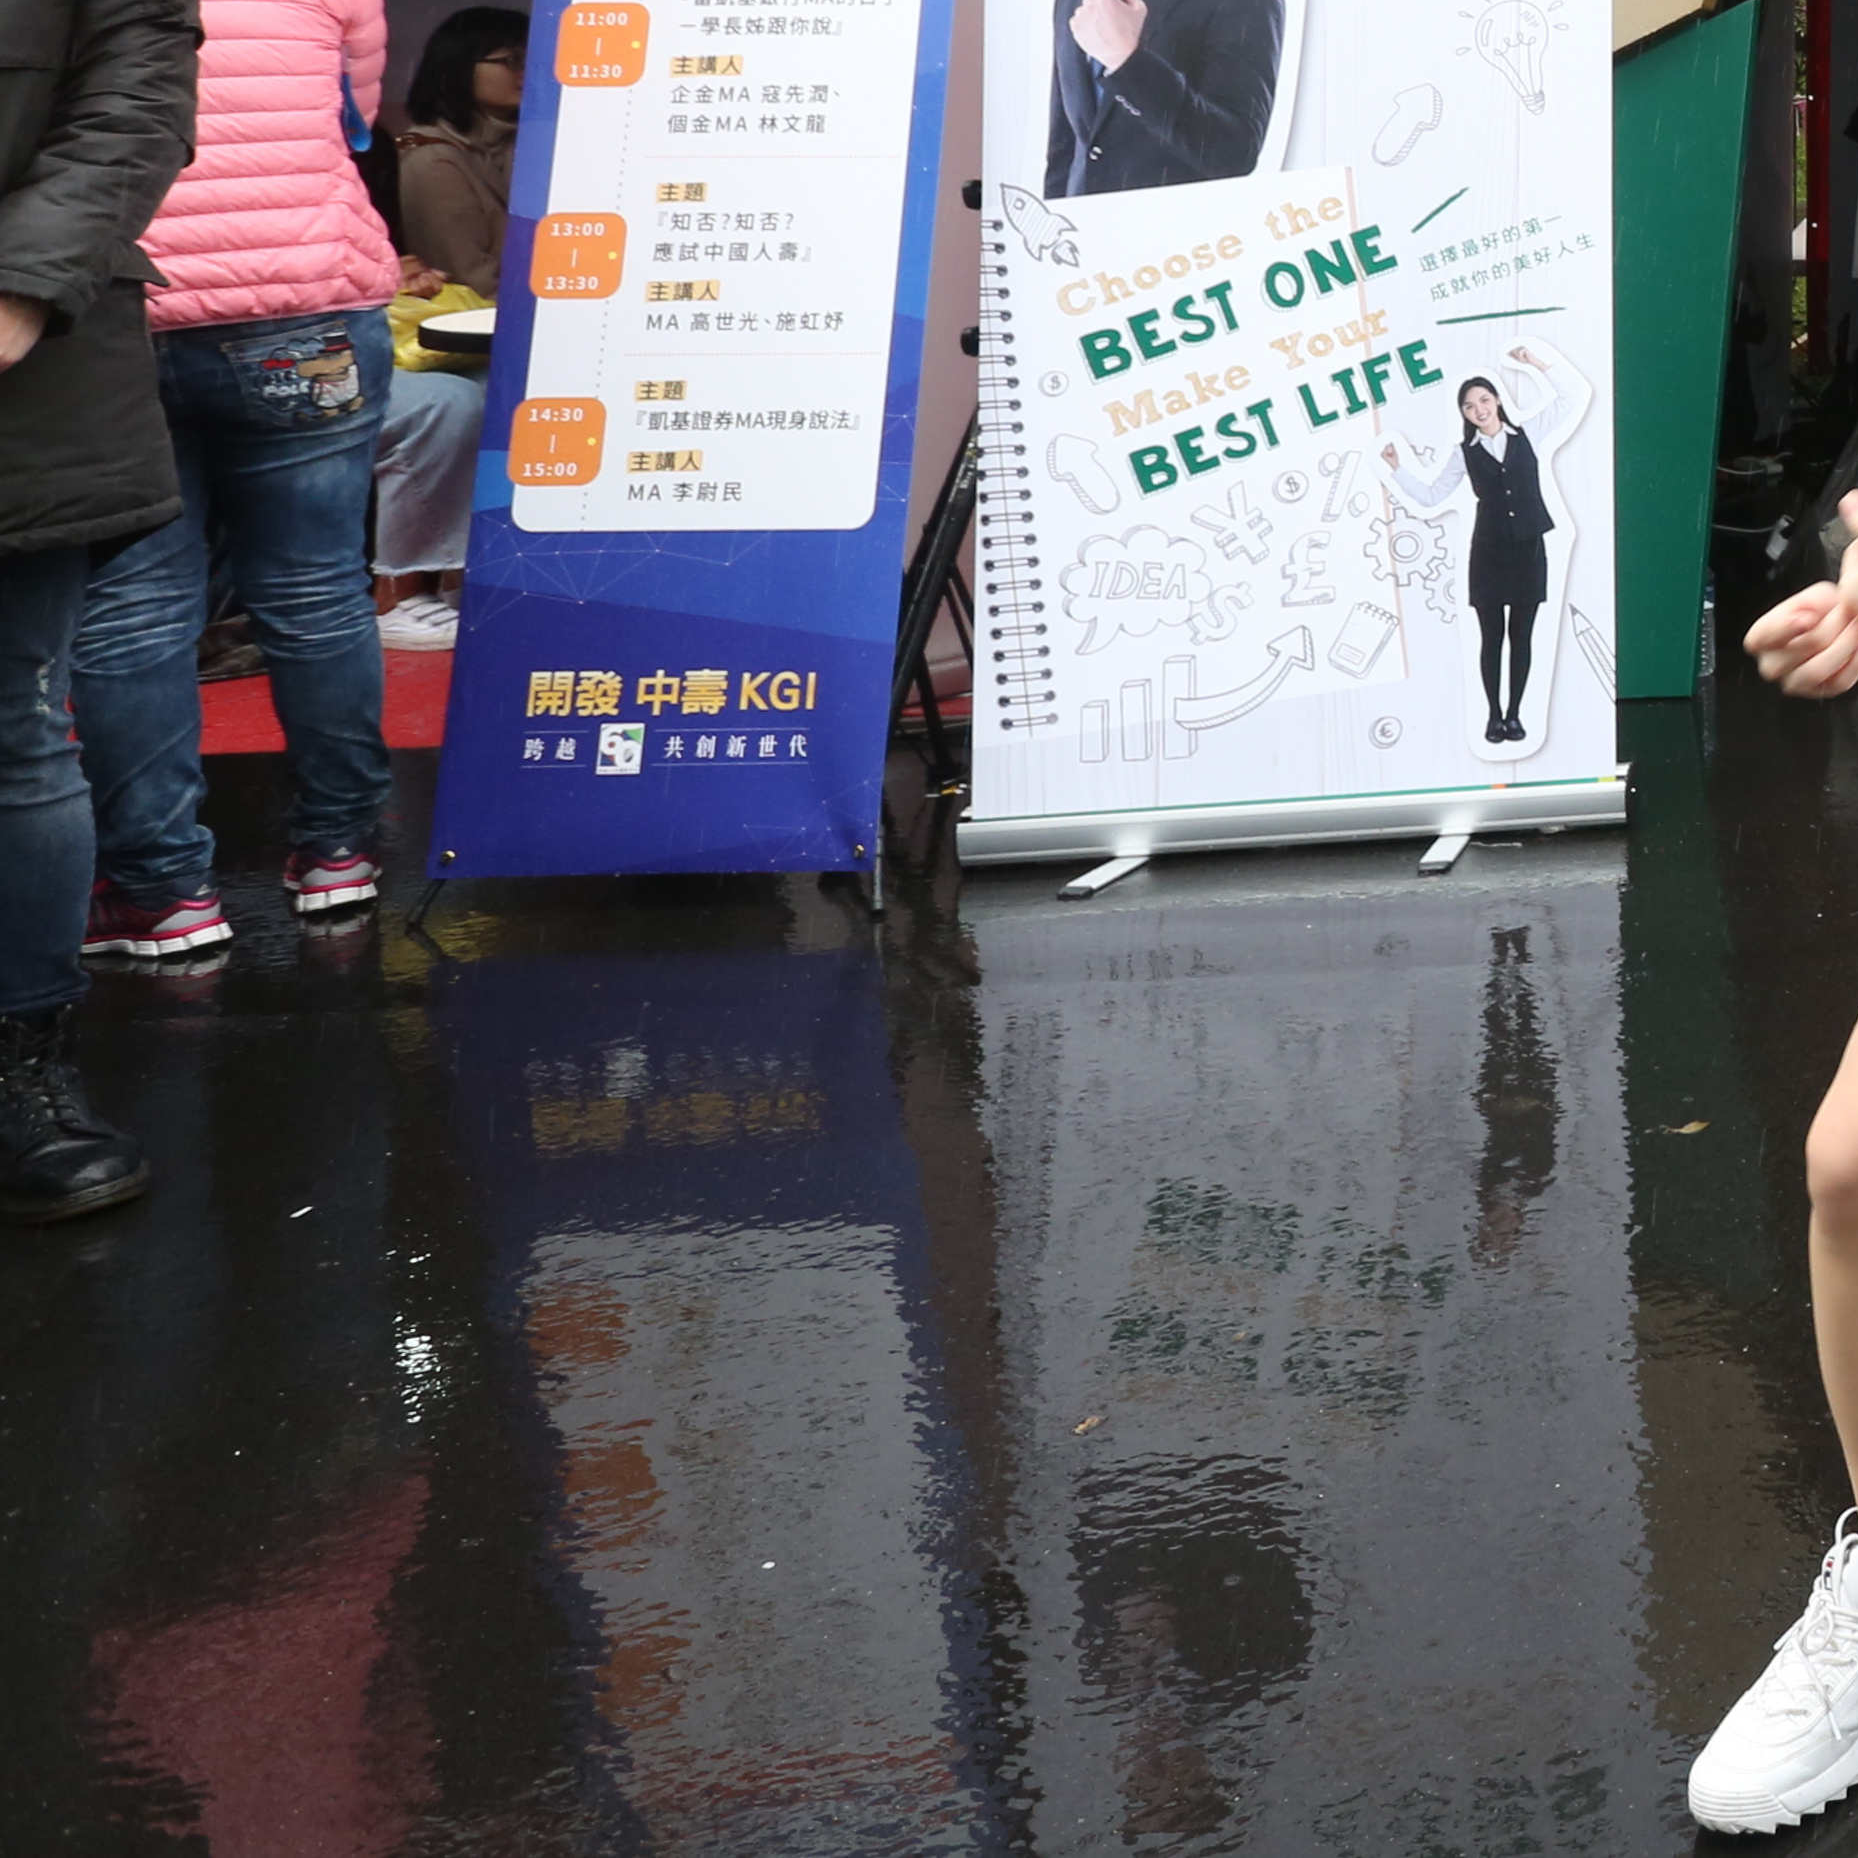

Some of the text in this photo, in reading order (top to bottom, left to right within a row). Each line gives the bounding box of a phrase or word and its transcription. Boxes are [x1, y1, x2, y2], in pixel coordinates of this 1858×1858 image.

[574, 12, 629, 27] 11:00
[568, 64, 623, 79] 11:30
[672, 55, 742, 75] 主講人
[670, 84, 752, 105] 企金MA
[667, 113, 828, 135] 個金MA 林文龍
[658, 182, 705, 203] 主題
[550, 222, 606, 237] 13:00
[1057, 192, 1348, 318] Choose the
[1418, 215, 1563, 273] 選擇最好的第一
[1429, 232, 1596, 303] 成就你的美好人生
[544, 276, 599, 291] 13:30
[647, 281, 719, 303] 主講人
[1077, 224, 1399, 384] BEST ONE
[645, 313, 680, 331] MA
[1102, 307, 1390, 438] Make Your
[636, 380, 685, 402] 主題
[527, 407, 584, 423] 14:30
[1127, 338, 1445, 500] BEST LIFE
[521, 462, 578, 478] 15:00
[628, 450, 701, 472] 主講人
[627, 483, 662, 502] MA
[1087, 560, 1188, 603] IDEA
[525, 668, 818, 718] 開發 中壽 KGI
[522, 737, 577, 762] 跨越
[662, 734, 809, 760] 共創新世代
